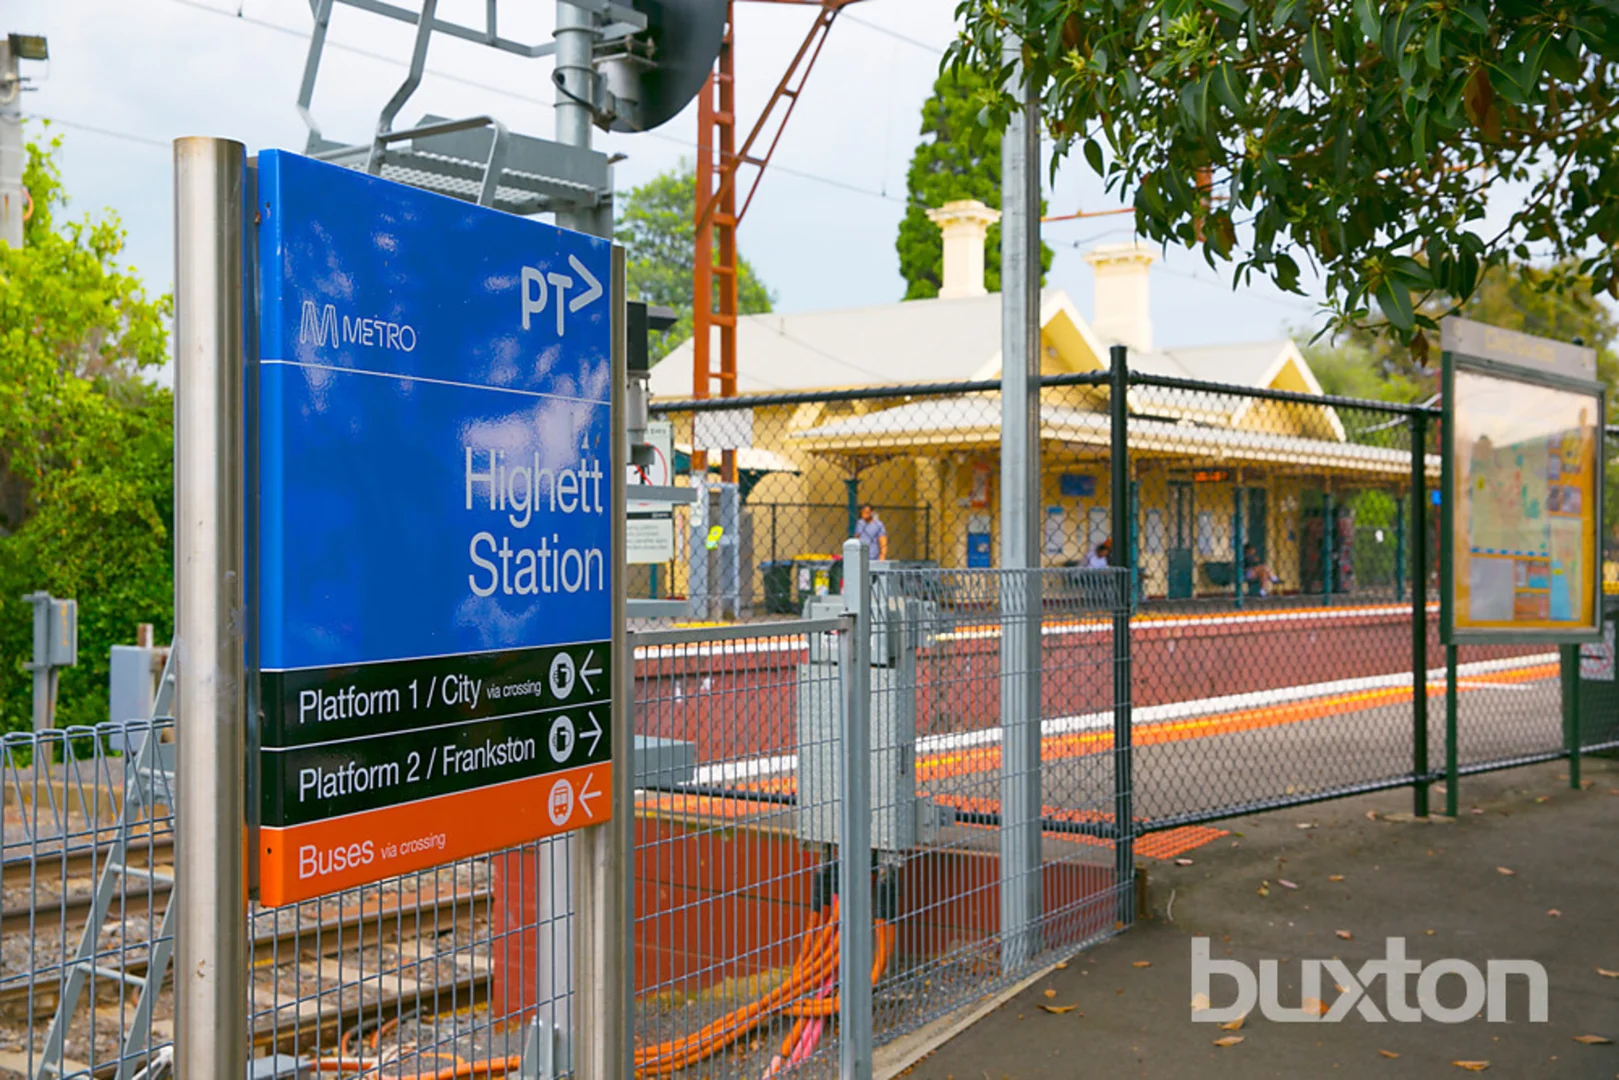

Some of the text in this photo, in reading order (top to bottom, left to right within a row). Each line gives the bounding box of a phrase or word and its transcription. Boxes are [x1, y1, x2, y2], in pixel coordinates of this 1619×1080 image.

[343, 314, 417, 352] METRO
[465, 446, 603, 529] Highett
[468, 531, 603, 597] Station
[299, 674, 542, 724] Platform 1 / City via crossing
[299, 735, 536, 802] Platform 2 / Frankston
[299, 832, 446, 880] Buses via crossing
